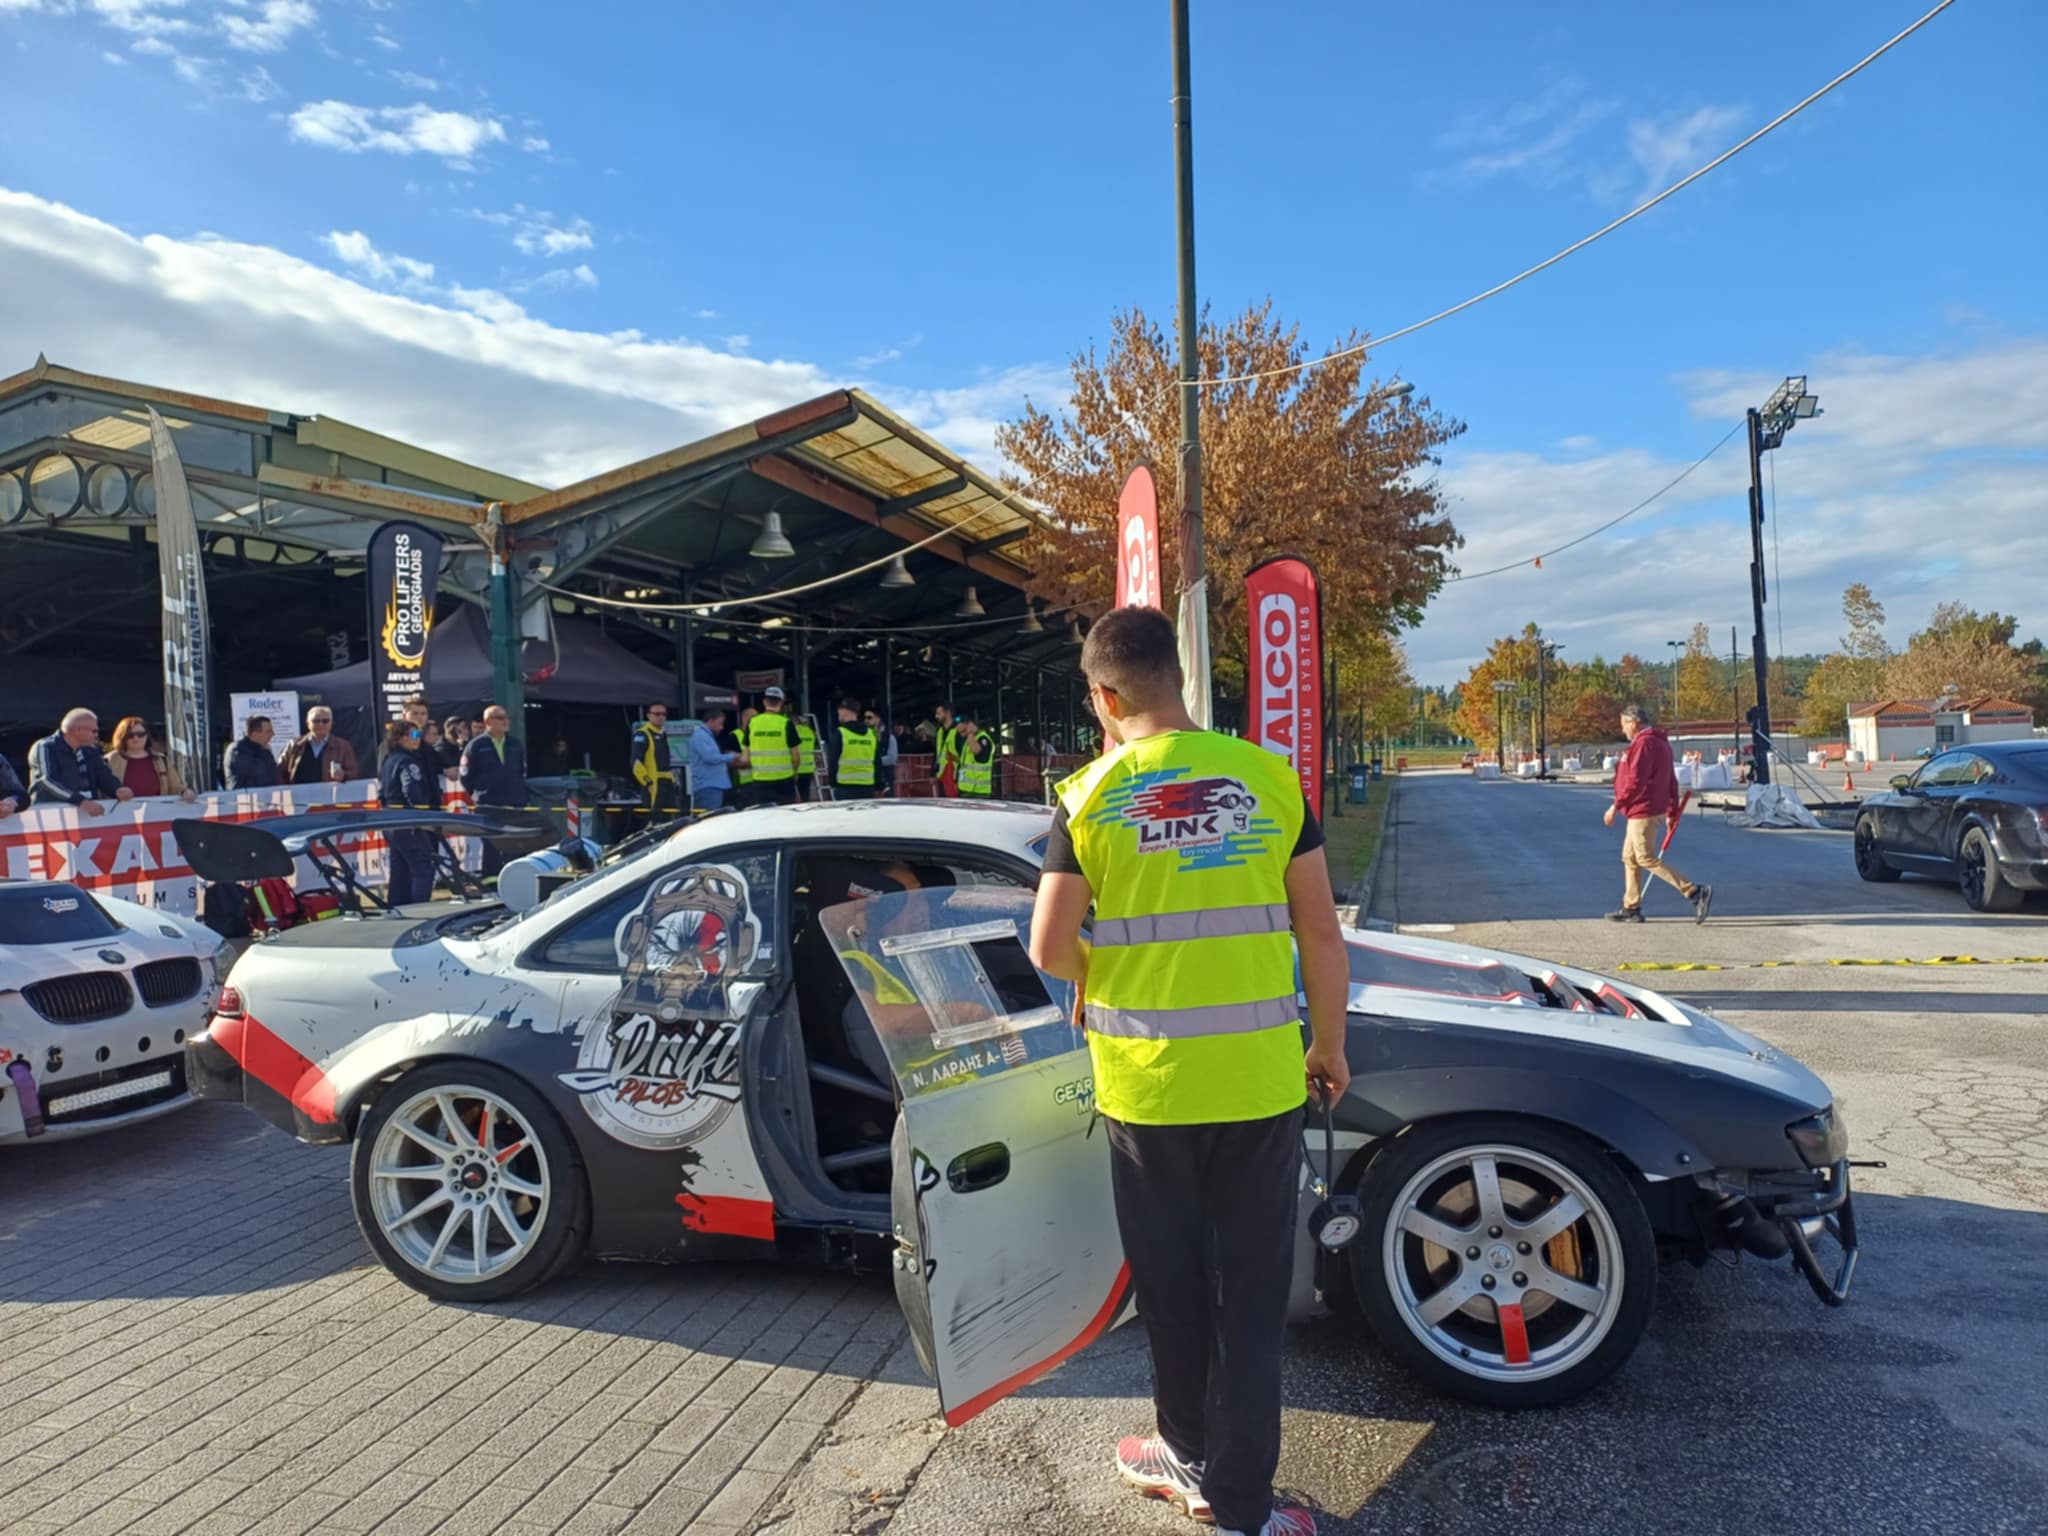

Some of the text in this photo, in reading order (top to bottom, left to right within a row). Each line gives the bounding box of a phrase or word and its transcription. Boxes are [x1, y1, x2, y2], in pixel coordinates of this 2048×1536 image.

[395, 534, 411, 646] PRO LIFTERS
[411, 549, 423, 634] GEORGIADIS
[1265, 609, 1293, 766] ALCO
[1301, 606, 1312, 800] LUMINIUM SYSTEMS
[6, 831, 188, 880] EXAL
[1141, 814, 1219, 843] LINK
[1170, 836, 1221, 848] Management
[608, 1013, 743, 1098] Drift
[932, 1053, 984, 1082] ΛΑΡΔΗΣ
[615, 1078, 690, 1105] PILOTS
